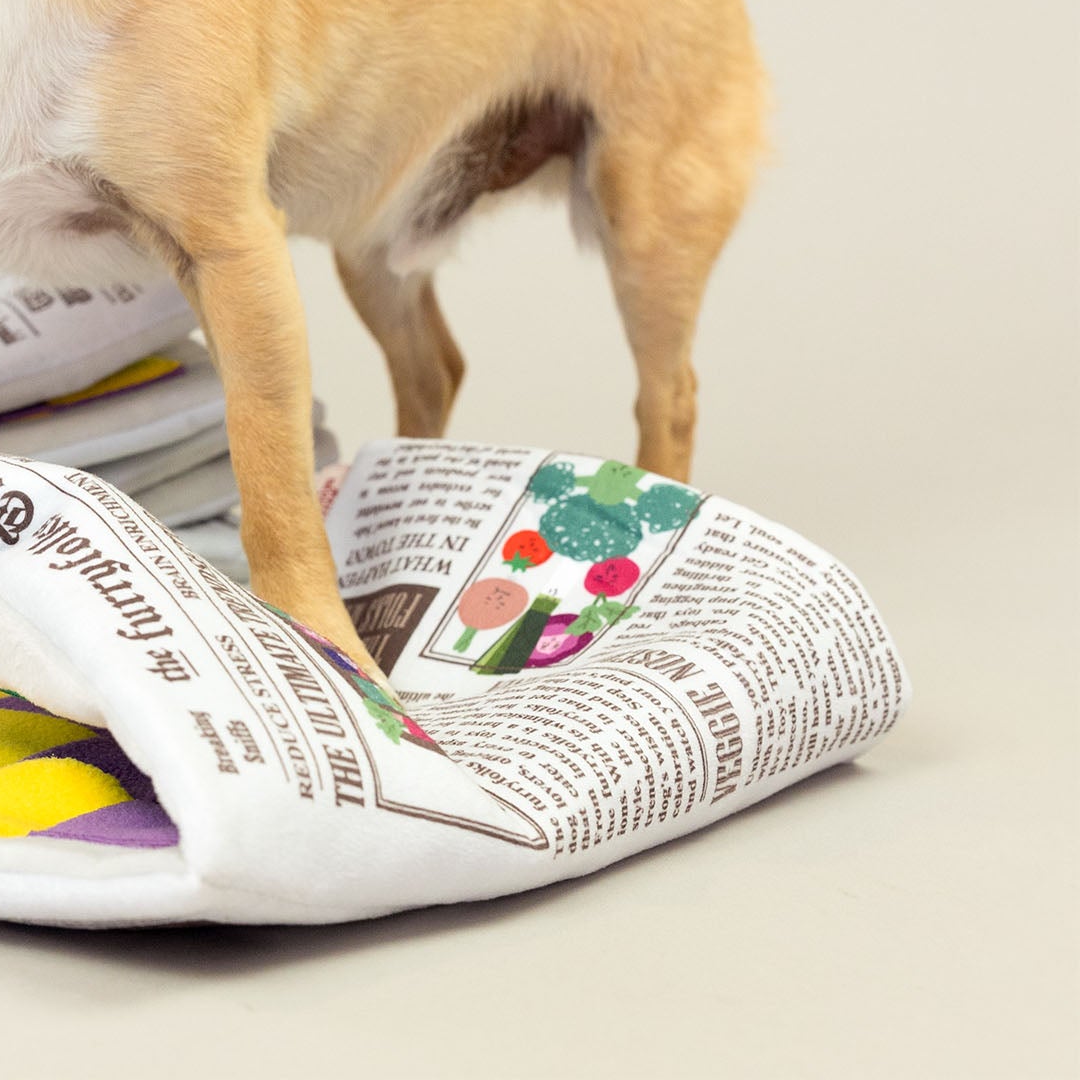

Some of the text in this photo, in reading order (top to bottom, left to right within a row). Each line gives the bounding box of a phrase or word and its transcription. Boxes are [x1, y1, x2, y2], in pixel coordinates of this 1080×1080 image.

[64, 471, 202, 601] BRAIN ENRICHMENT
[703, 527, 737, 545] that
[713, 511, 743, 531] Let
[747, 524, 784, 547] soul.
[397, 533, 437, 549] THE
[438, 535, 470, 552] IN
[694, 540, 739, 558] ready
[785, 547, 818, 569] and
[27, 513, 173, 640] furryfolks
[388, 556, 453, 577] WHAT
[671, 566, 733, 583] thrilling
[684, 557, 736, 574] hidden
[738, 555, 770, 571] Get
[741, 540, 818, 587] adventure
[661, 582, 738, 594] strengthen
[739, 568, 802, 599] uncover
[743, 591, 784, 611] them
[744, 580, 762, 590] in
[819, 569, 854, 606] body
[827, 562, 871, 612] begin!
[625, 623, 652, 631] red
[747, 613, 788, 648] onion
[772, 591, 820, 635] engage
[803, 602, 831, 629] and
[853, 609, 877, 650] both
[869, 613, 888, 644] fun
[787, 615, 821, 668] Watch
[146, 648, 191, 684] the
[214, 634, 272, 699] STRESS
[649, 594, 820, 765] will have your playful pup begging
[757, 650, 779, 692] This
[787, 658, 805, 690] and
[884, 646, 904, 707] veggie
[587, 695, 624, 713] and
[606, 688, 644, 711] Step
[631, 687, 674, 715] your
[708, 637, 775, 781] with the furryfolks
[731, 669, 762, 711] your
[821, 673, 833, 727] more.
[248, 625, 366, 808] THE ULTIMATE
[522, 725, 540, 736] is
[524, 703, 603, 735] furryfolks
[567, 728, 590, 743] its
[596, 713, 615, 726] in
[188, 708, 241, 776] Breaking
[227, 718, 266, 765] Sniffs
[261, 702, 315, 801] REDUCE
[500, 734, 587, 780] interactive
[517, 751, 537, 761] to
[609, 741, 634, 767] the
[622, 713, 666, 767] wishes
[670, 718, 697, 774] watch
[684, 681, 744, 807] VEGGIE
[744, 714, 764, 787] Unleash
[537, 763, 580, 799] cater
[540, 732, 613, 800] furryfolks
[590, 743, 622, 786] With
[615, 728, 657, 829] trendsetter
[648, 712, 684, 819] celebration.
[465, 760, 548, 812] furryfolks
[517, 764, 569, 810] lovers,
[657, 771, 672, 823] dog's
[686, 778, 698, 815] and
[567, 814, 580, 855] dog
[578, 807, 590, 852] that
[587, 787, 604, 847] From
[606, 807, 617, 842] the
[549, 817, 565, 861] The
